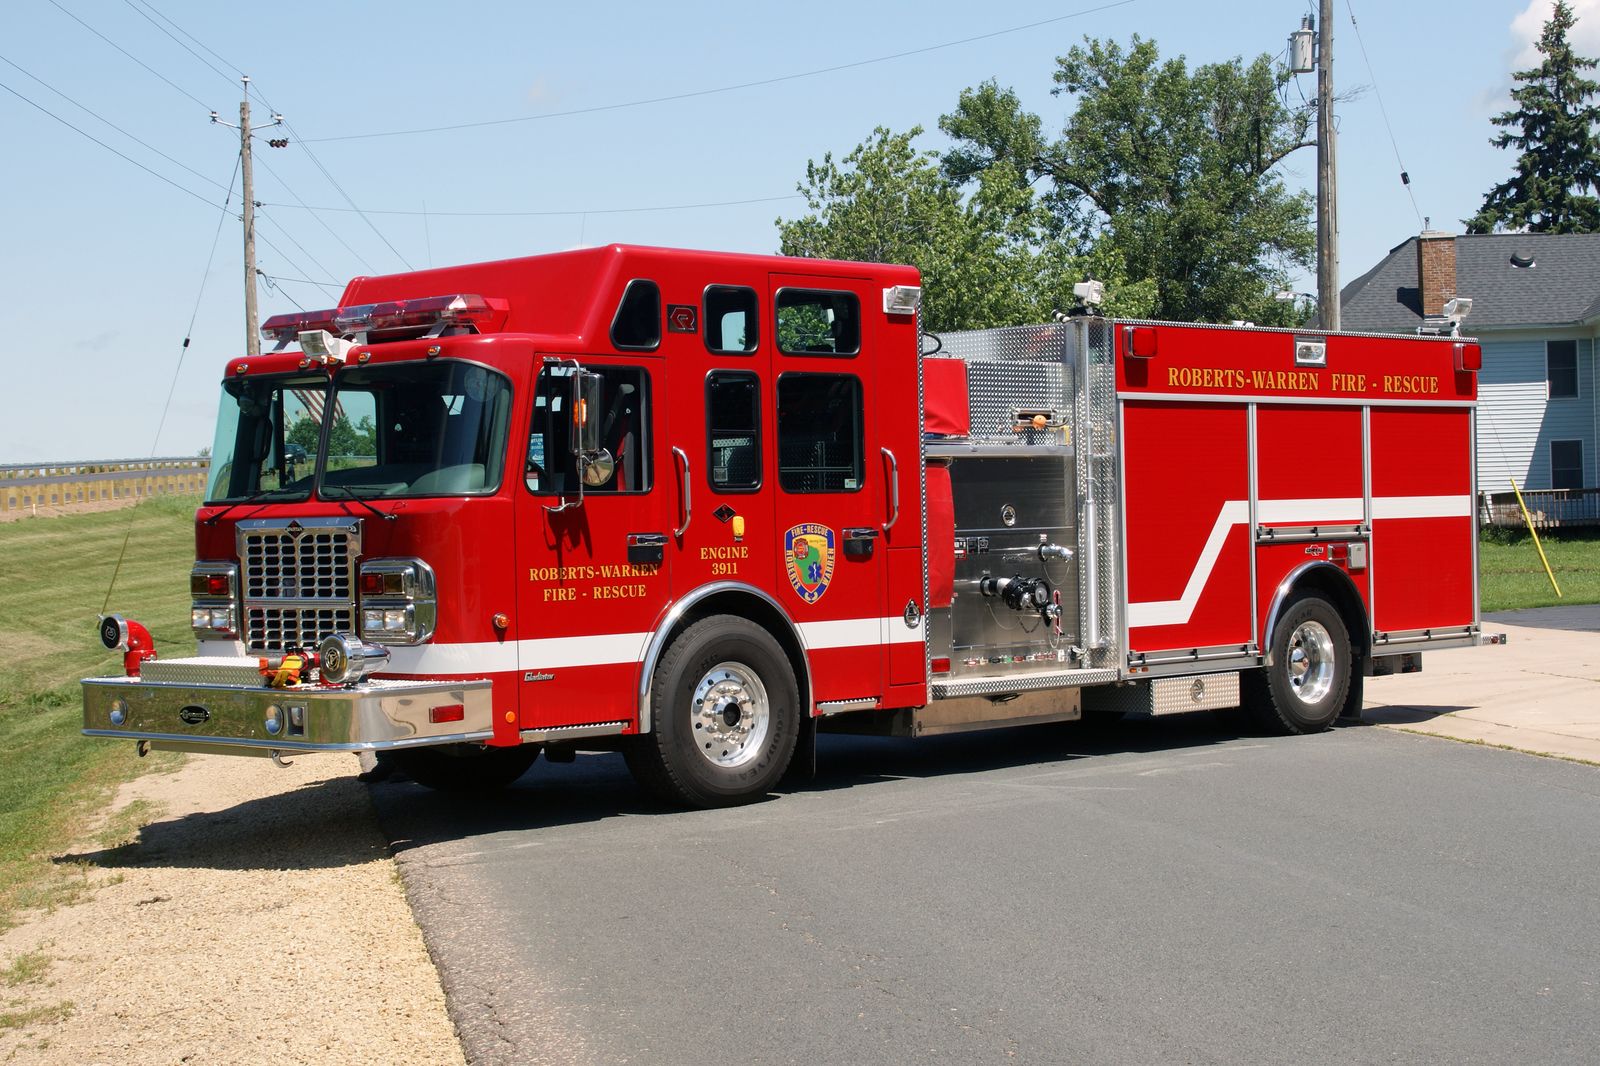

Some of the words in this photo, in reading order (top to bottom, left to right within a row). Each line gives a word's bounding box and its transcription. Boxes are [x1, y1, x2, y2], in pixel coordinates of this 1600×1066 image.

[1168, 367, 1319, 391] ROBERTS-WARREN
[1331, 373, 1366, 392] FIRE
[1383, 375, 1439, 394] RESCUE
[792, 525, 828, 537] FIRE-RESCUE
[700, 546, 749, 560] ENGINE
[529, 563, 659, 581] ROBERTS-WARREN
[711, 562, 739, 576] 3911
[786, 550, 801, 589] ROBERTS
[822, 548, 834, 586] WARREN
[543, 587, 577, 602] FIRE
[593, 584, 647, 599] RESCUE
